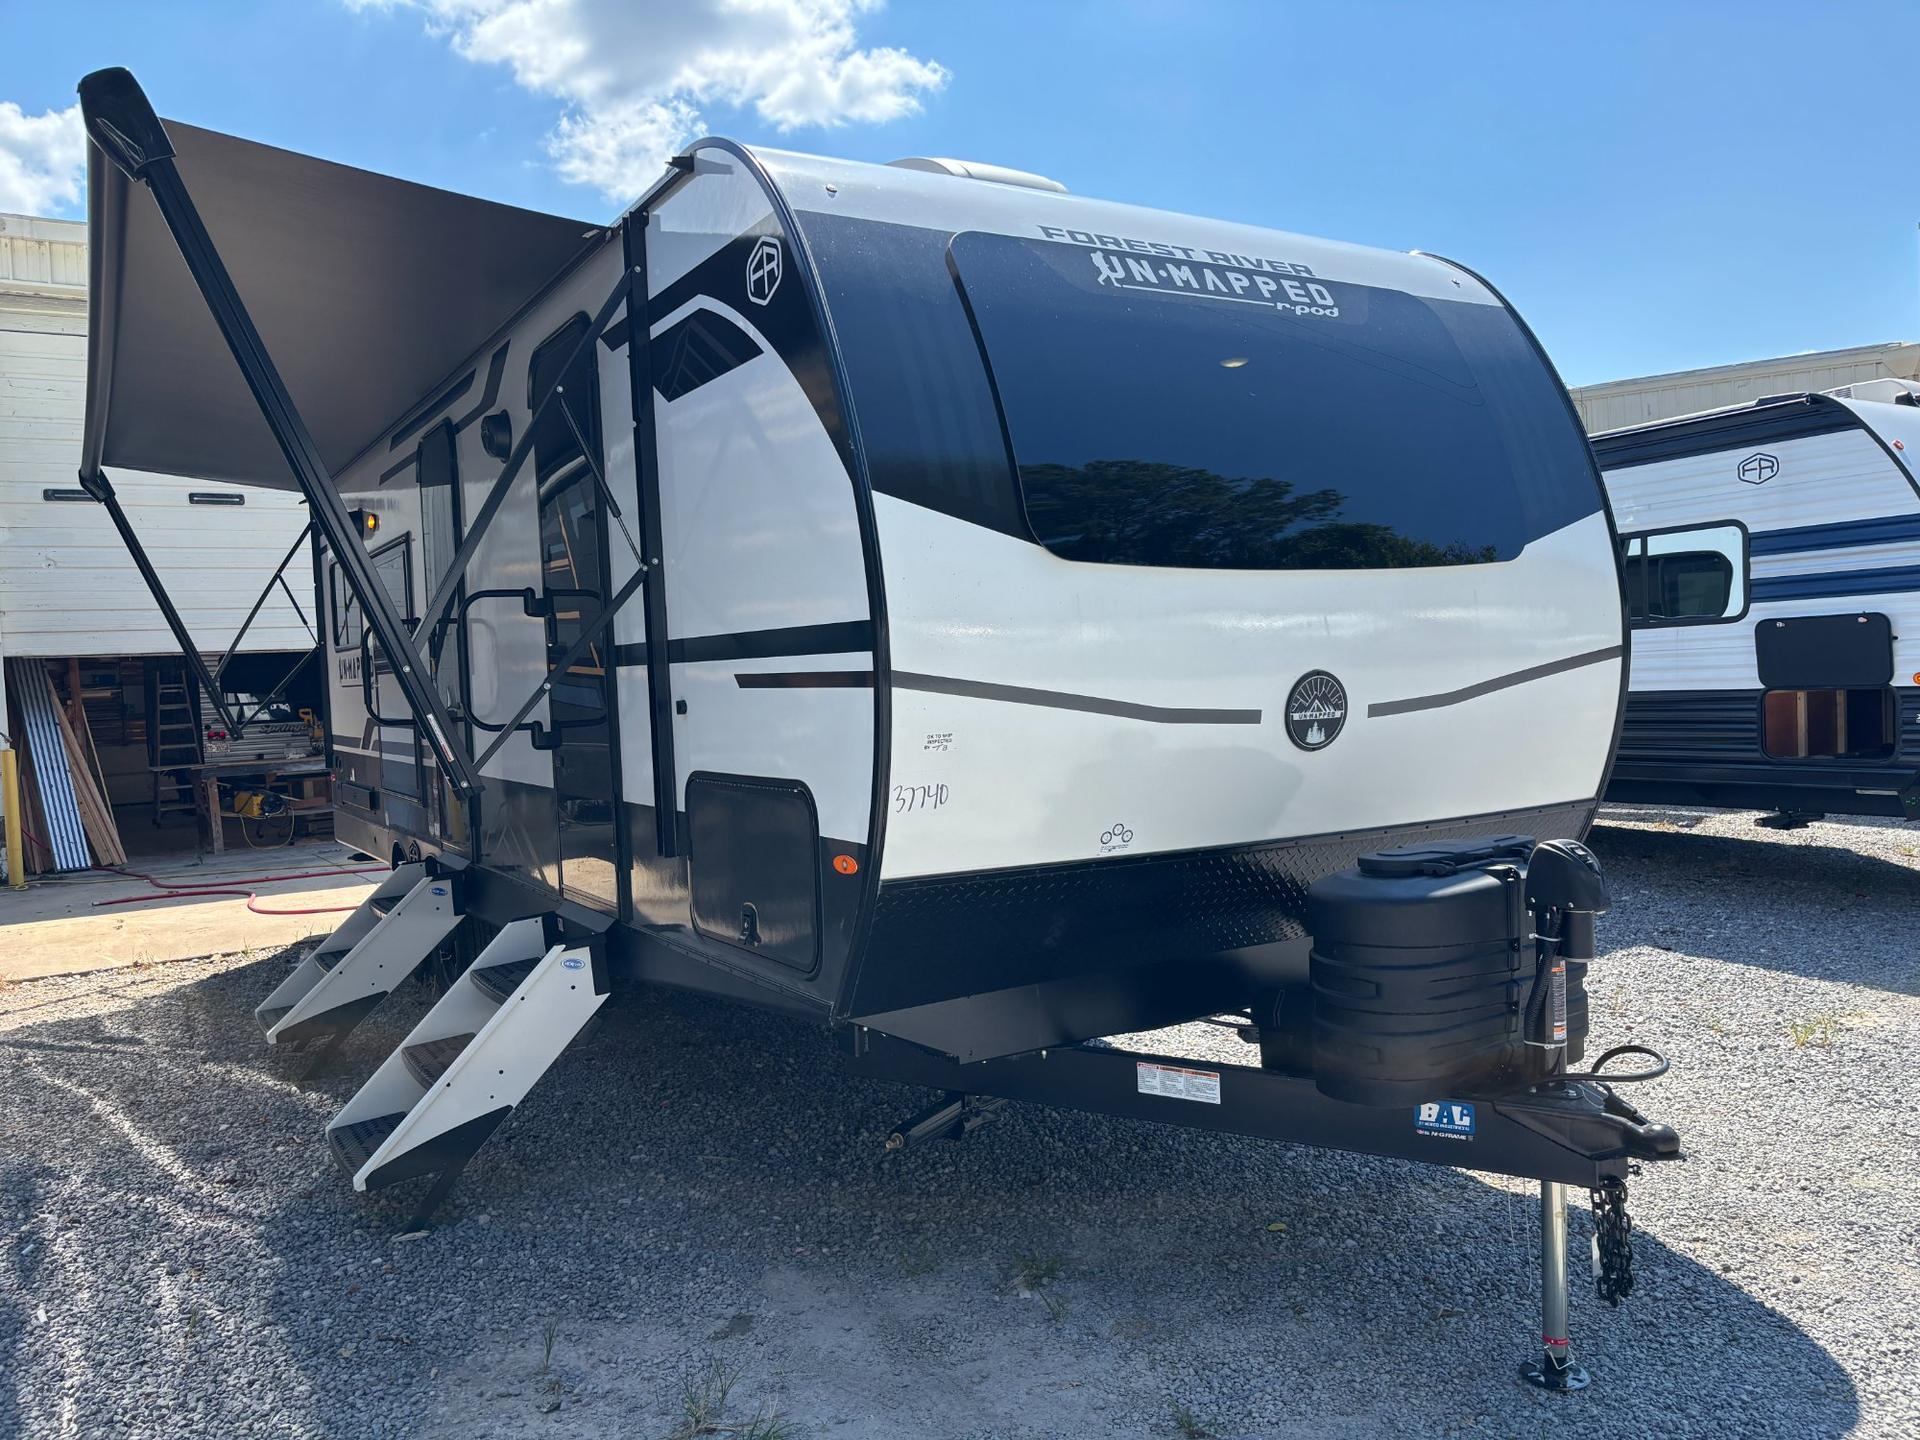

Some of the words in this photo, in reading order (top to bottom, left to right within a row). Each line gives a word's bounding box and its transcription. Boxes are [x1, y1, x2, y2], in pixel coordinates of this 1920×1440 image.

[1038, 225, 1196, 260] FOREST
[1203, 249, 1317, 277] RIVER
[893, 783, 949, 813] 37740
